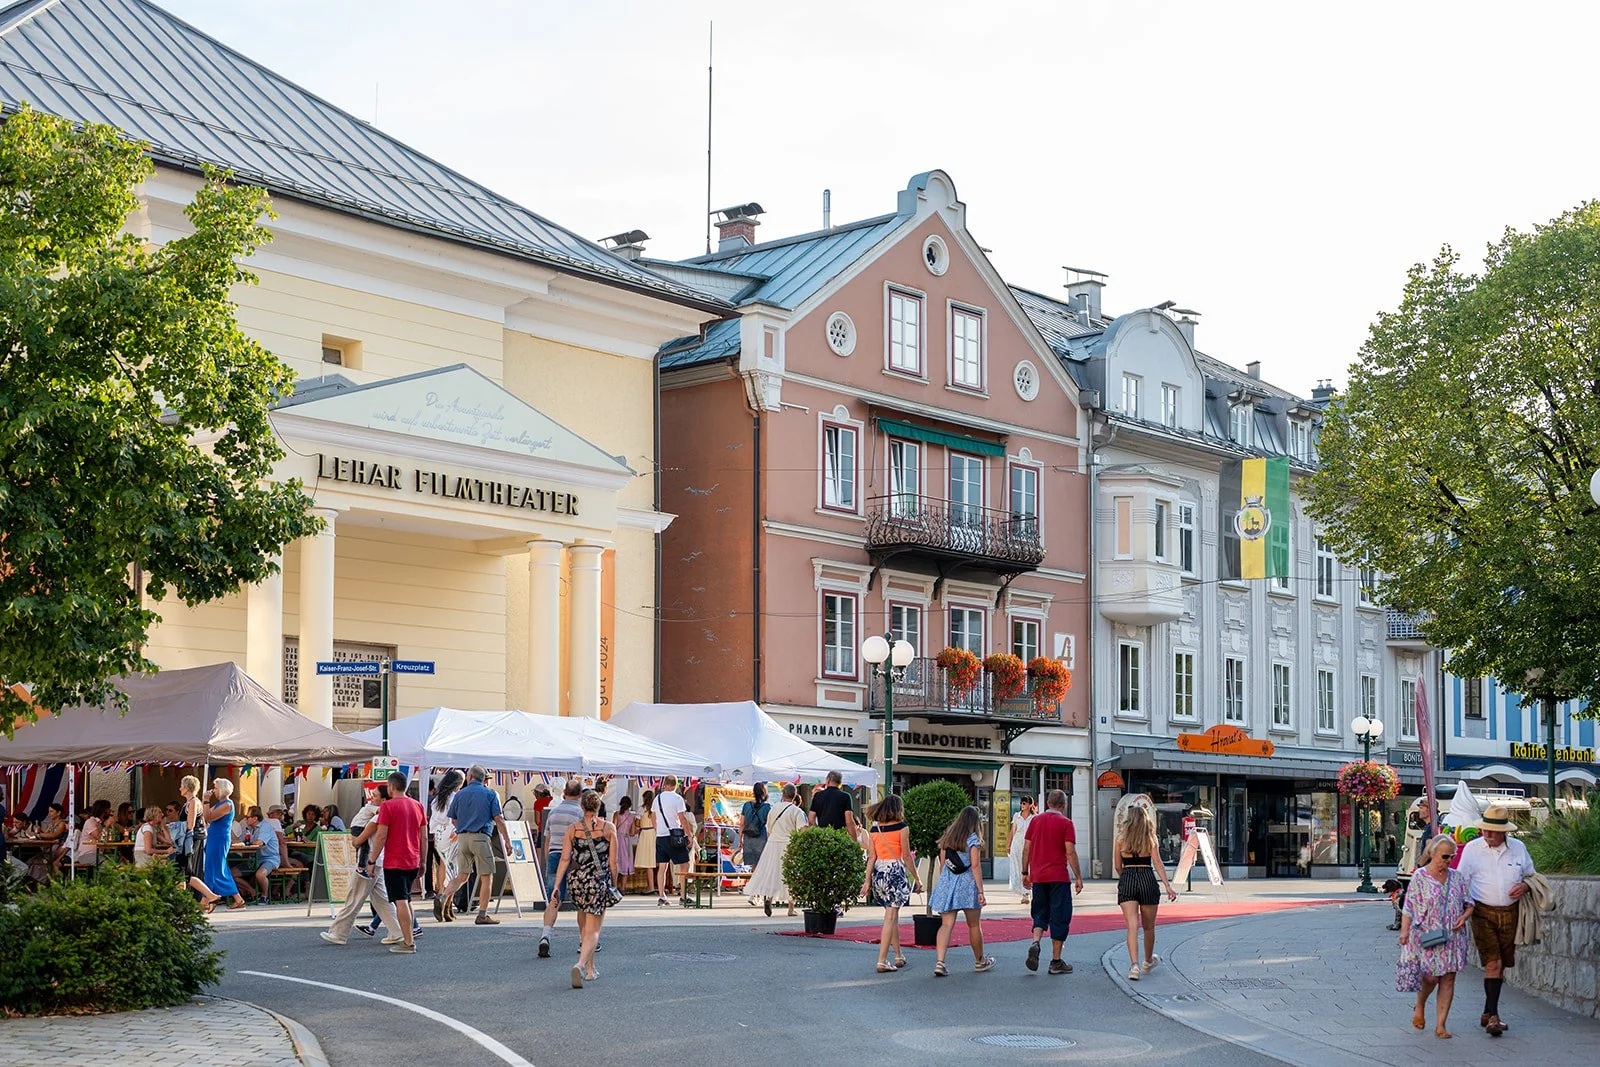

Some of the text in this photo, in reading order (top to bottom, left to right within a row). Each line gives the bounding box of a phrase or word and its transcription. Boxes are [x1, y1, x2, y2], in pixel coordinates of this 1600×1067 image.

[318, 453, 579, 516] LEHAR FILMTHEATER
[319, 664, 378, 673] Kaiser-Franz-Josef-Str.
[396, 663, 430, 672] Kreuzplatz
[789, 723, 854, 738] PHARMACIE
[897, 731, 992, 750] KURAPOTHEKE
[1510, 741, 1595, 762] Raiffeenbank
